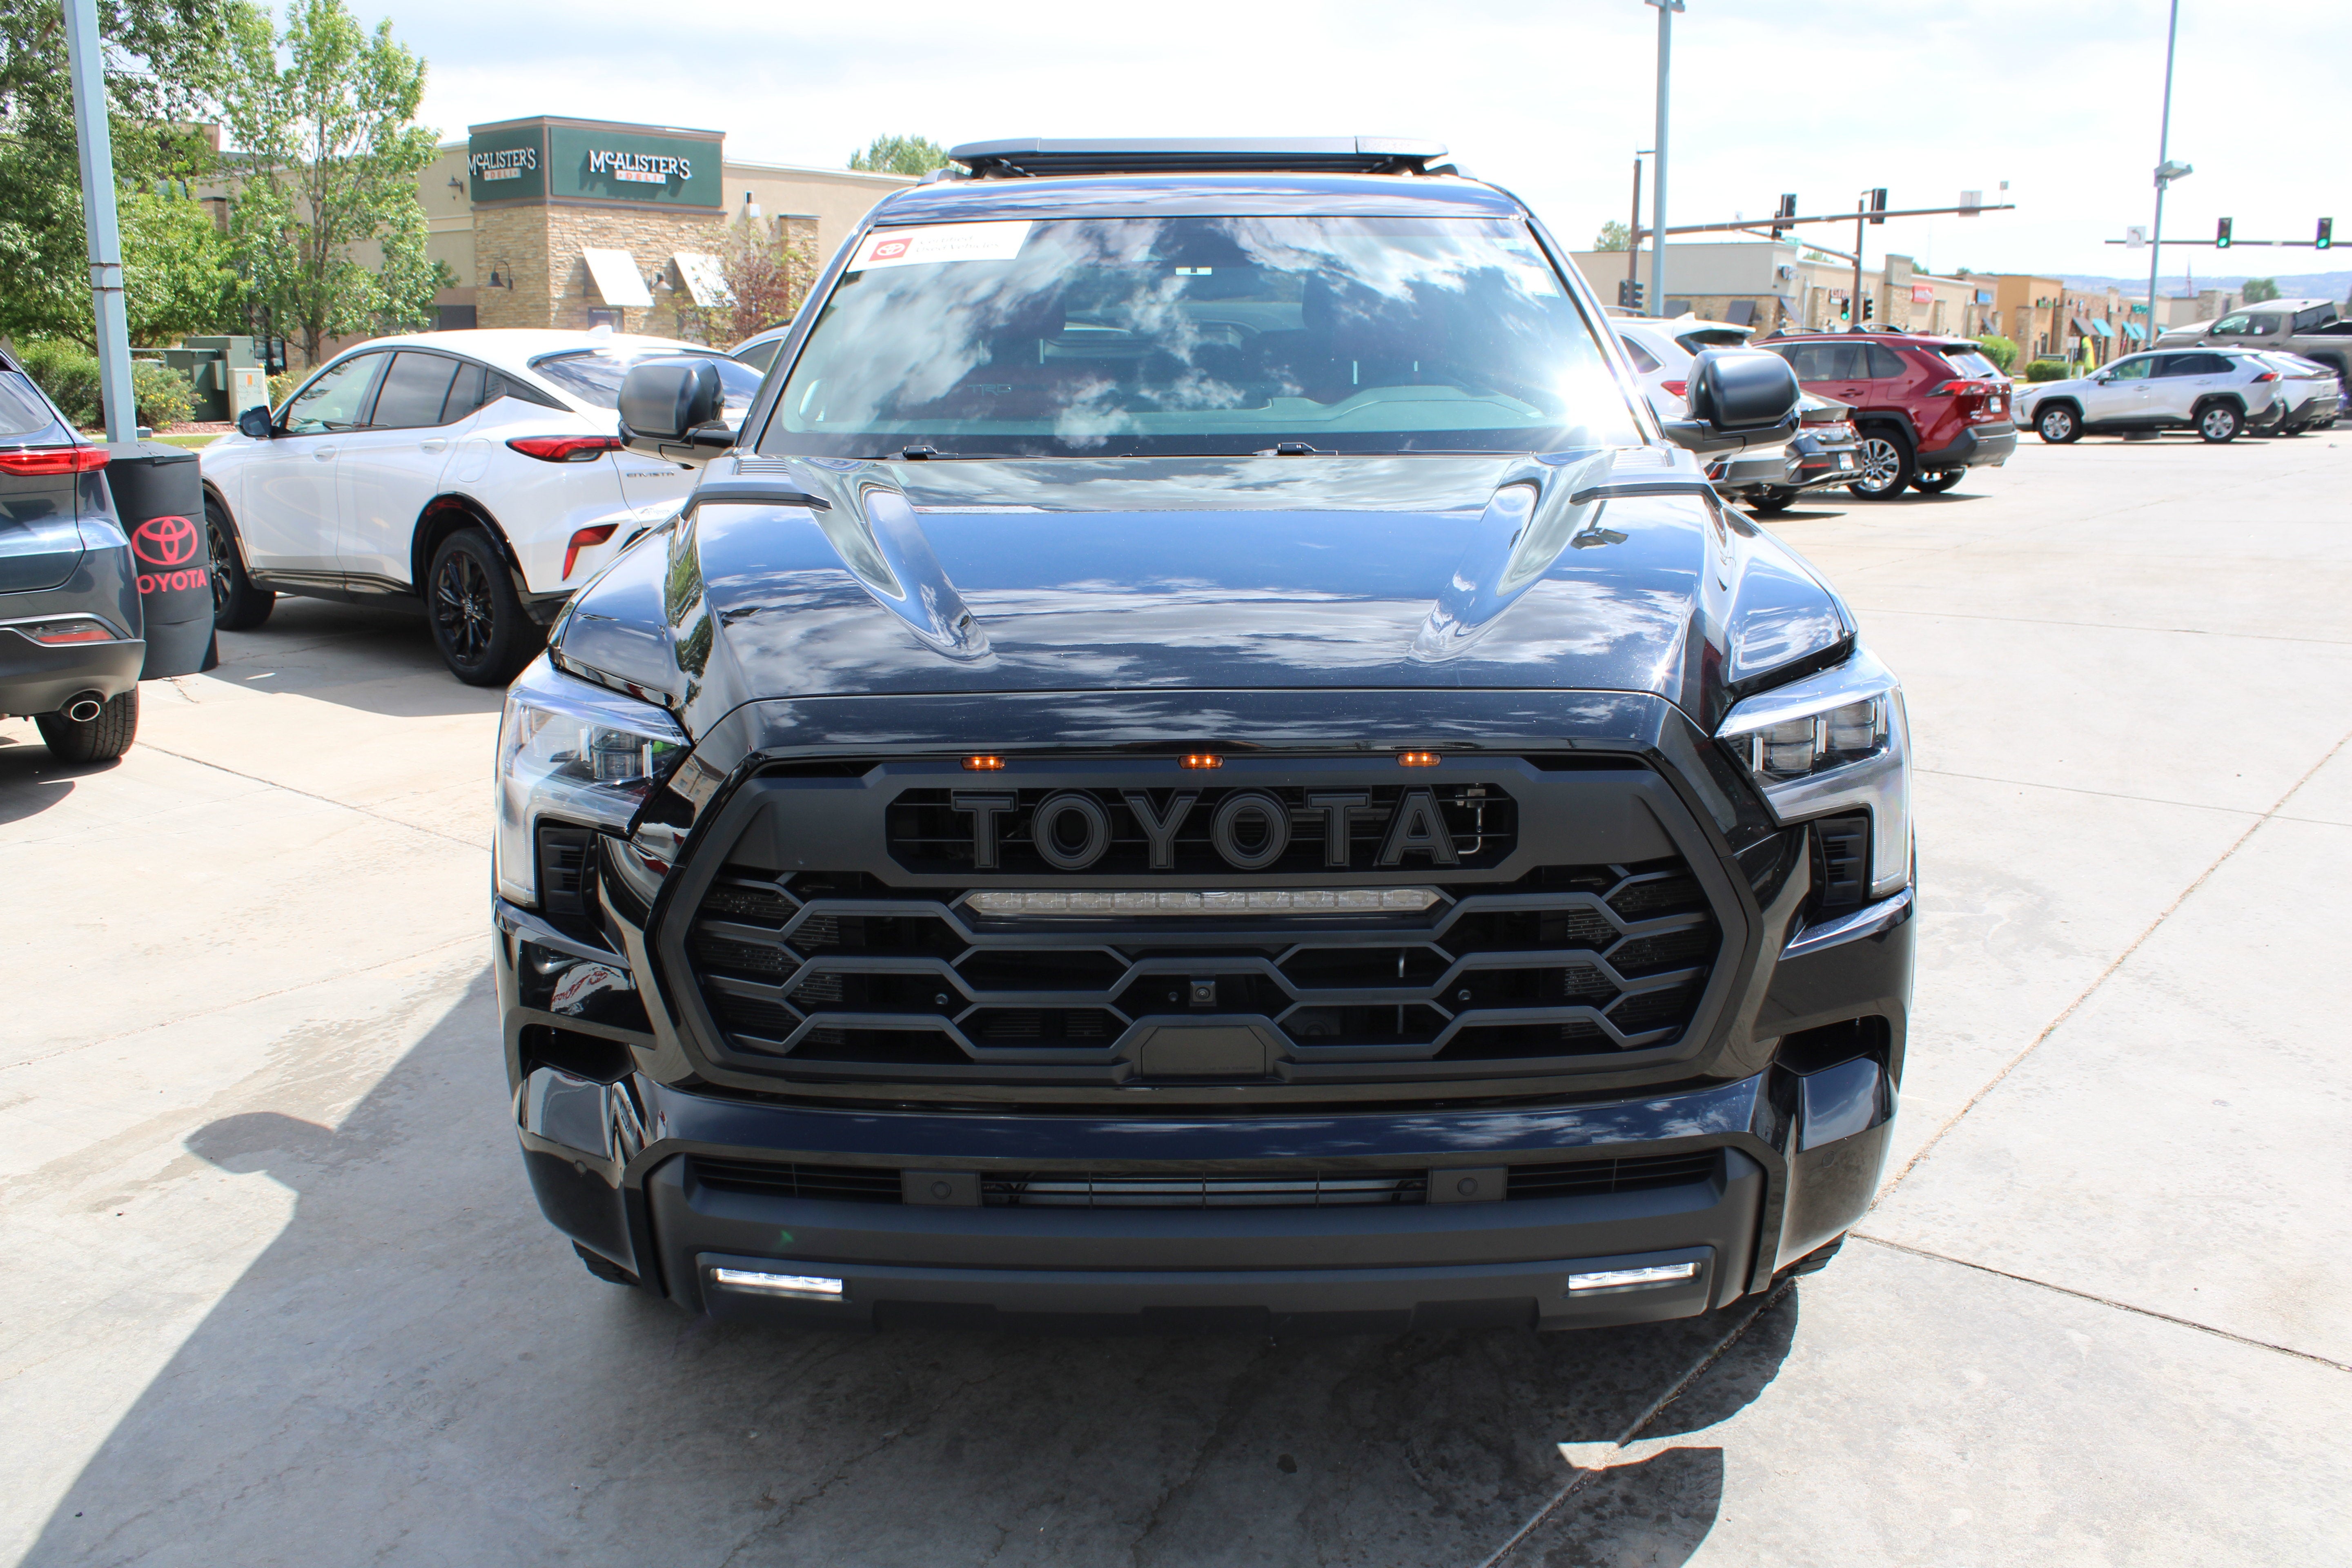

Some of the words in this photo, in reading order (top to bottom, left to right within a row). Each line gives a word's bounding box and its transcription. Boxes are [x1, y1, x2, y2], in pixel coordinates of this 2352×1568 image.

[491, 169, 512, 179] DELI
[626, 172, 657, 181] DELI
[136, 569, 207, 594] OYOTA
[951, 785, 1461, 871] TOYOTA
